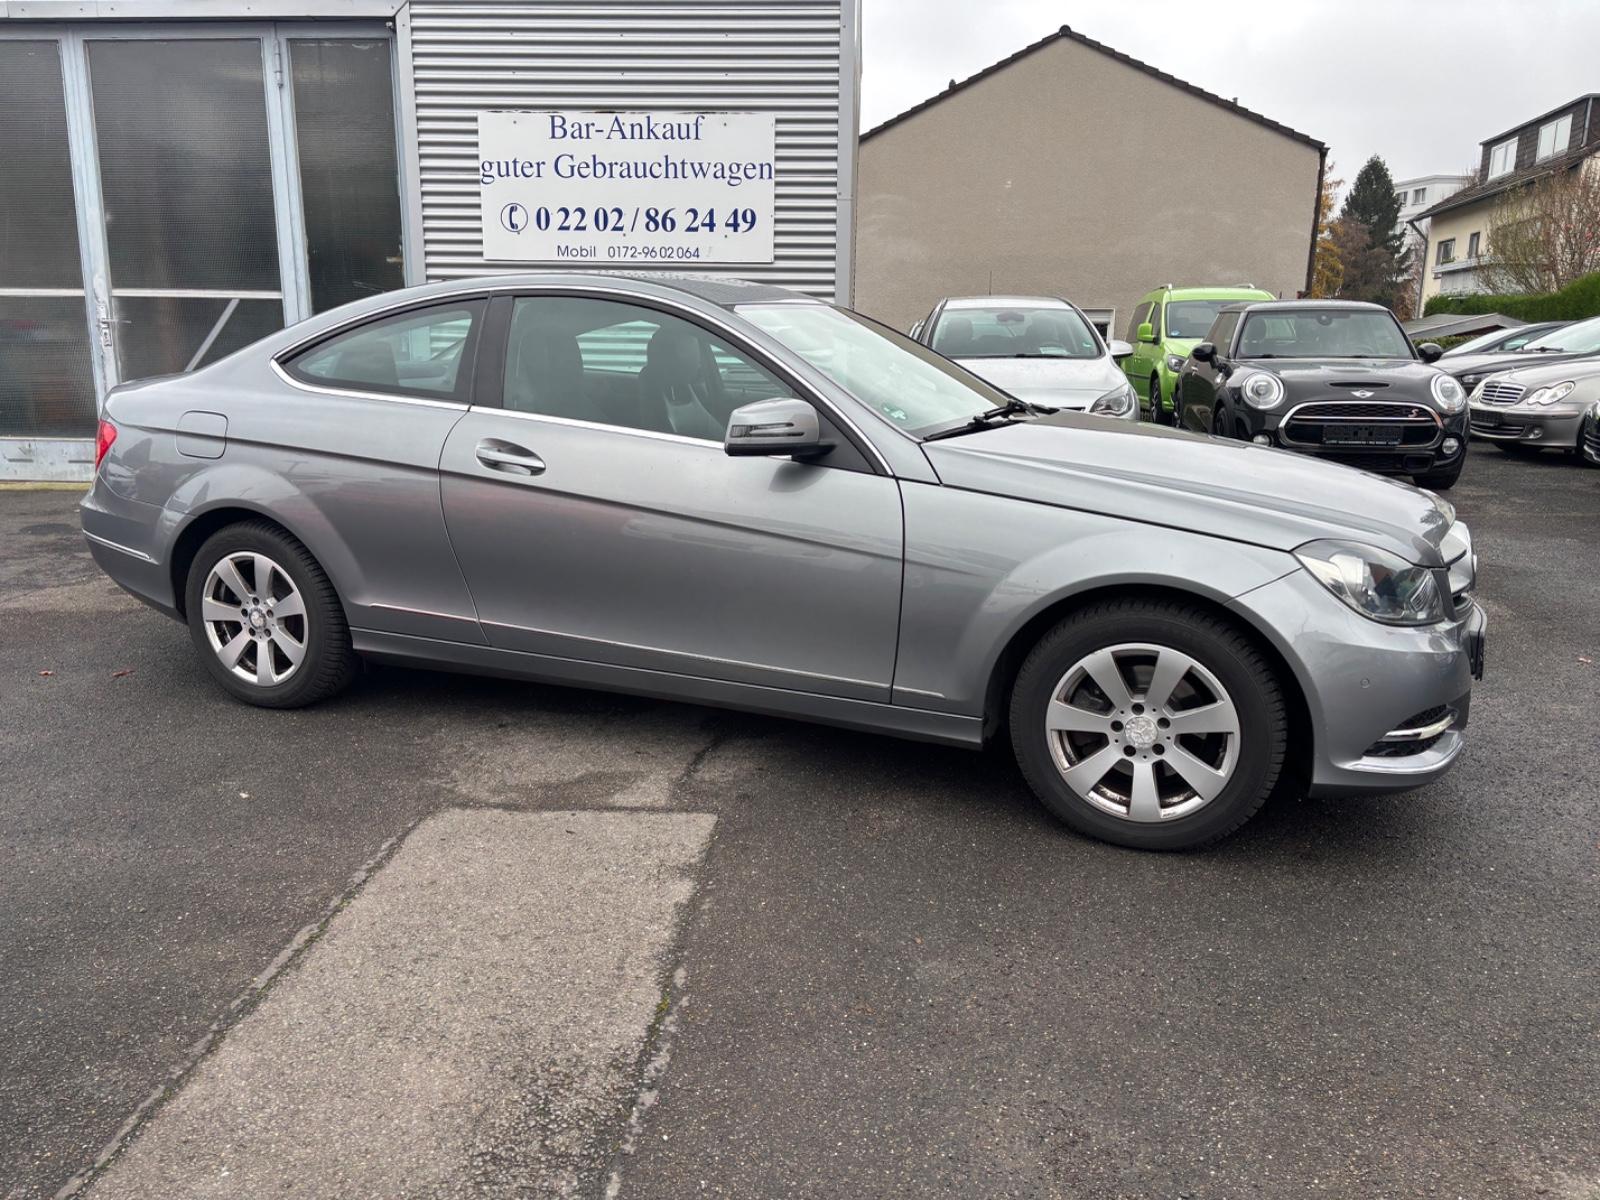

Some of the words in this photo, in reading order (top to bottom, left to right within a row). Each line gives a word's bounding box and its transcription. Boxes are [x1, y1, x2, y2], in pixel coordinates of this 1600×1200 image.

[549, 115, 706, 141] Bar-Ankauf
[480, 157, 546, 185] guter
[553, 153, 774, 187] Gebrauchtwagen
[556, 245, 597, 258] Mobil
